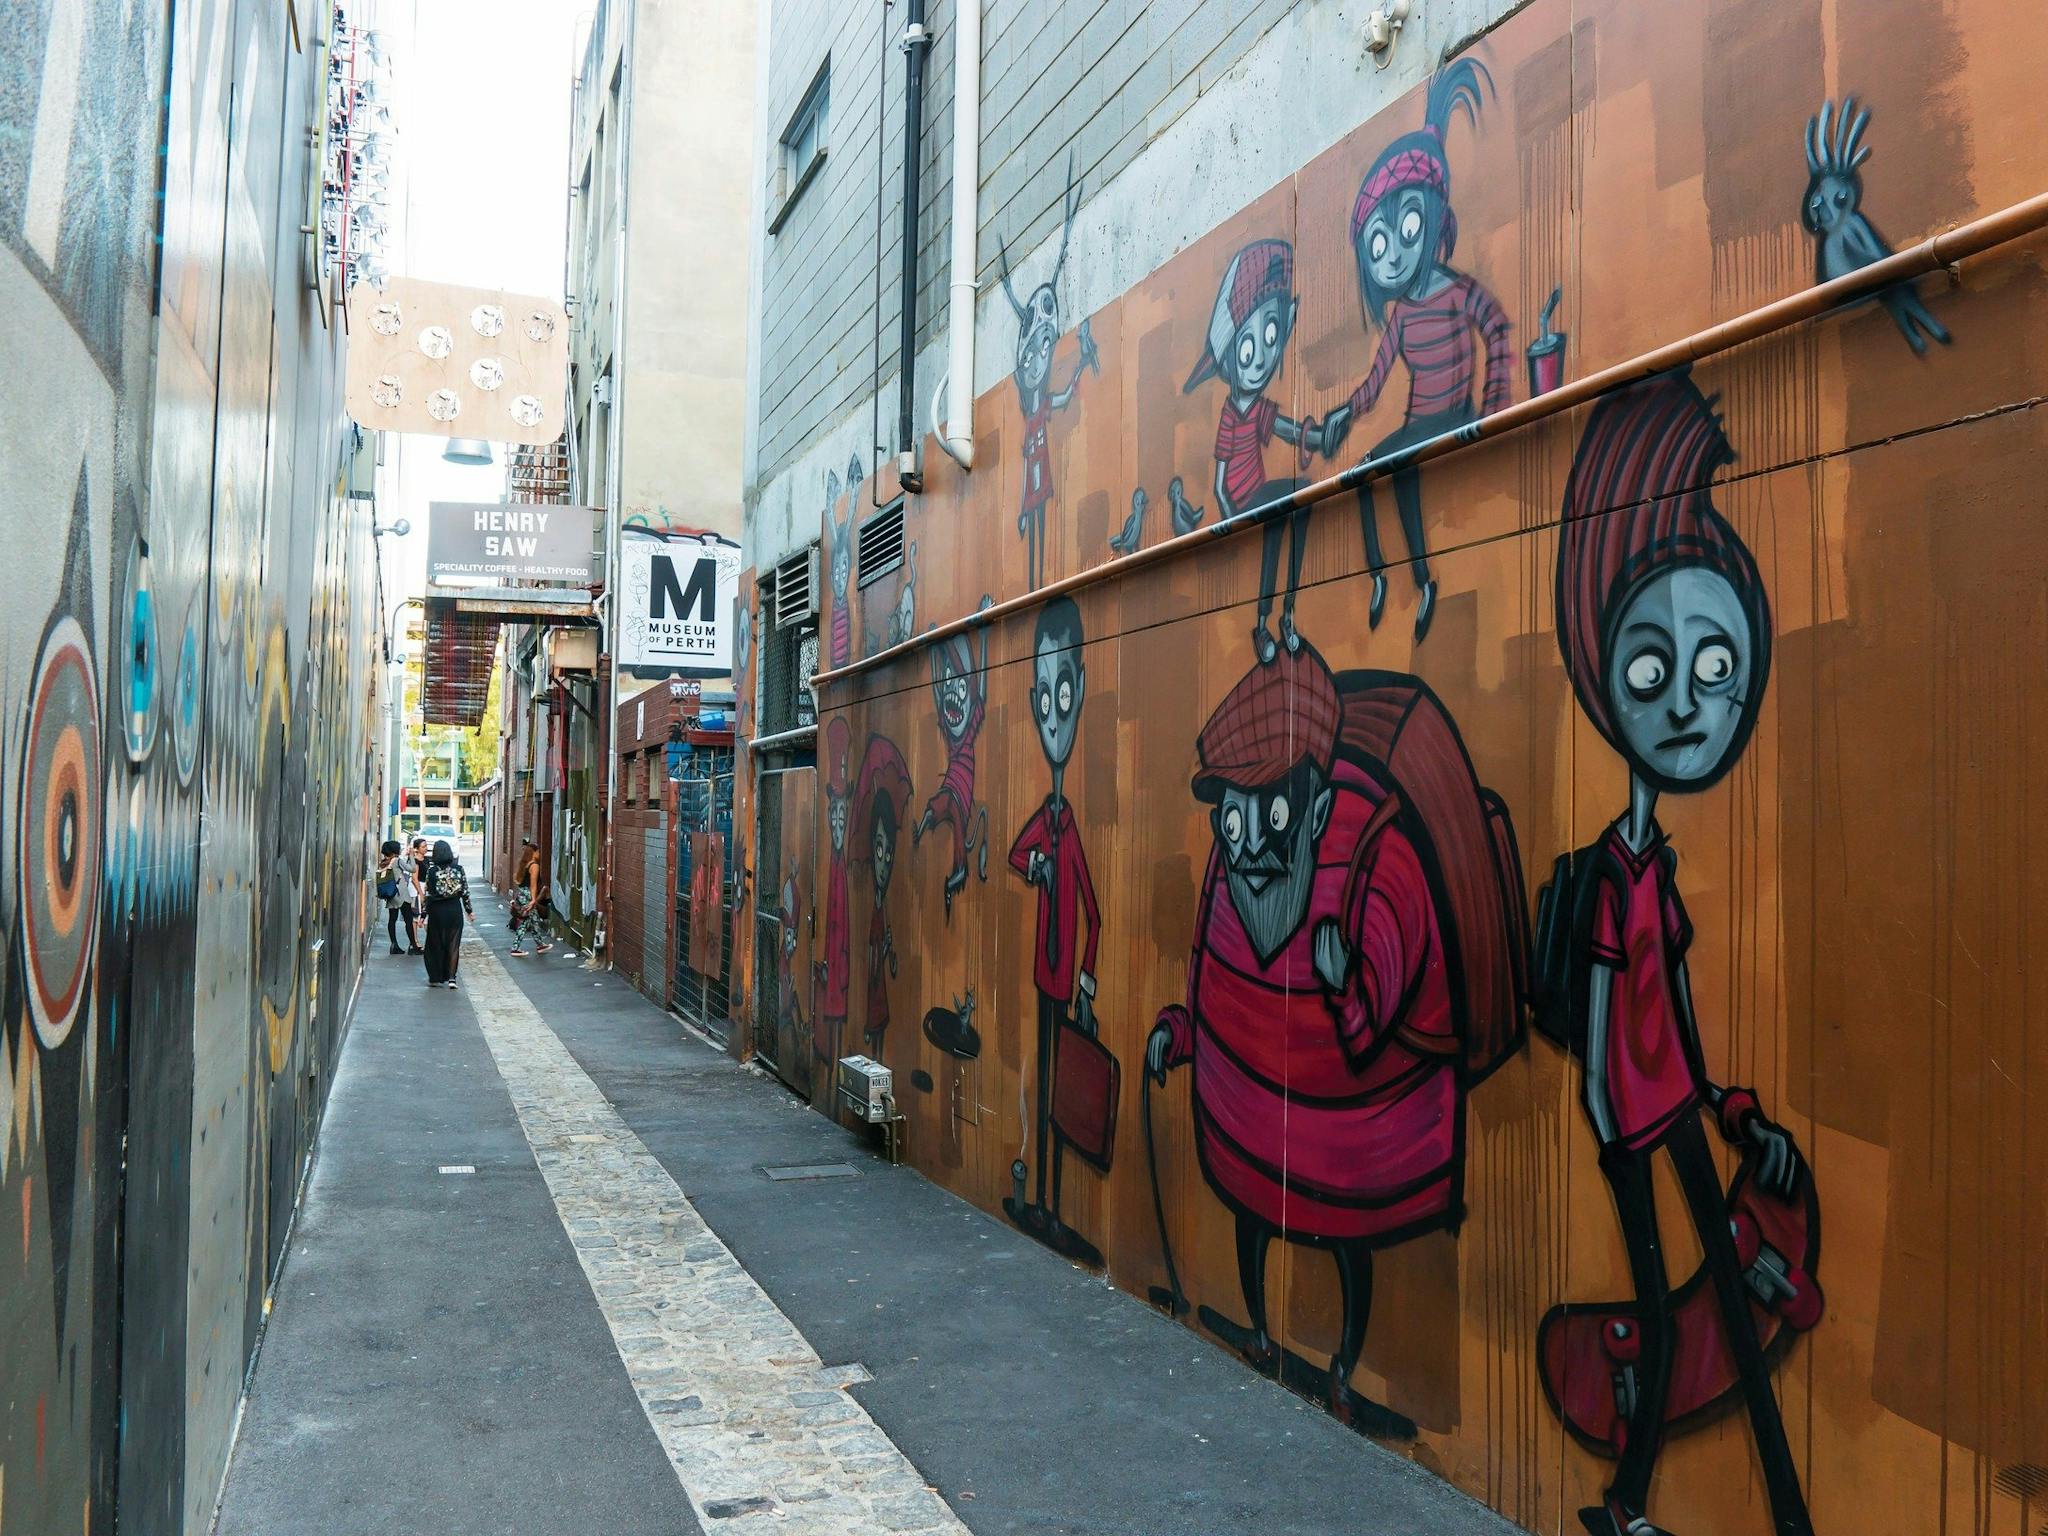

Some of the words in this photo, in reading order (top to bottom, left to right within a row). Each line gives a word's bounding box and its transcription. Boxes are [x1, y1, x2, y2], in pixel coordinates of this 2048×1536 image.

[474, 511, 549, 532] HENRY
[485, 537, 537, 557] SAW
[433, 562, 484, 573] SPECIALITY
[485, 564, 517, 573] COFFEE
[524, 565, 564, 575] HEALTHY
[566, 567, 589, 576] FOOD
[650, 554, 716, 622] M
[649, 623, 715, 636] MUSEUM
[666, 636, 715, 649] PERTH
